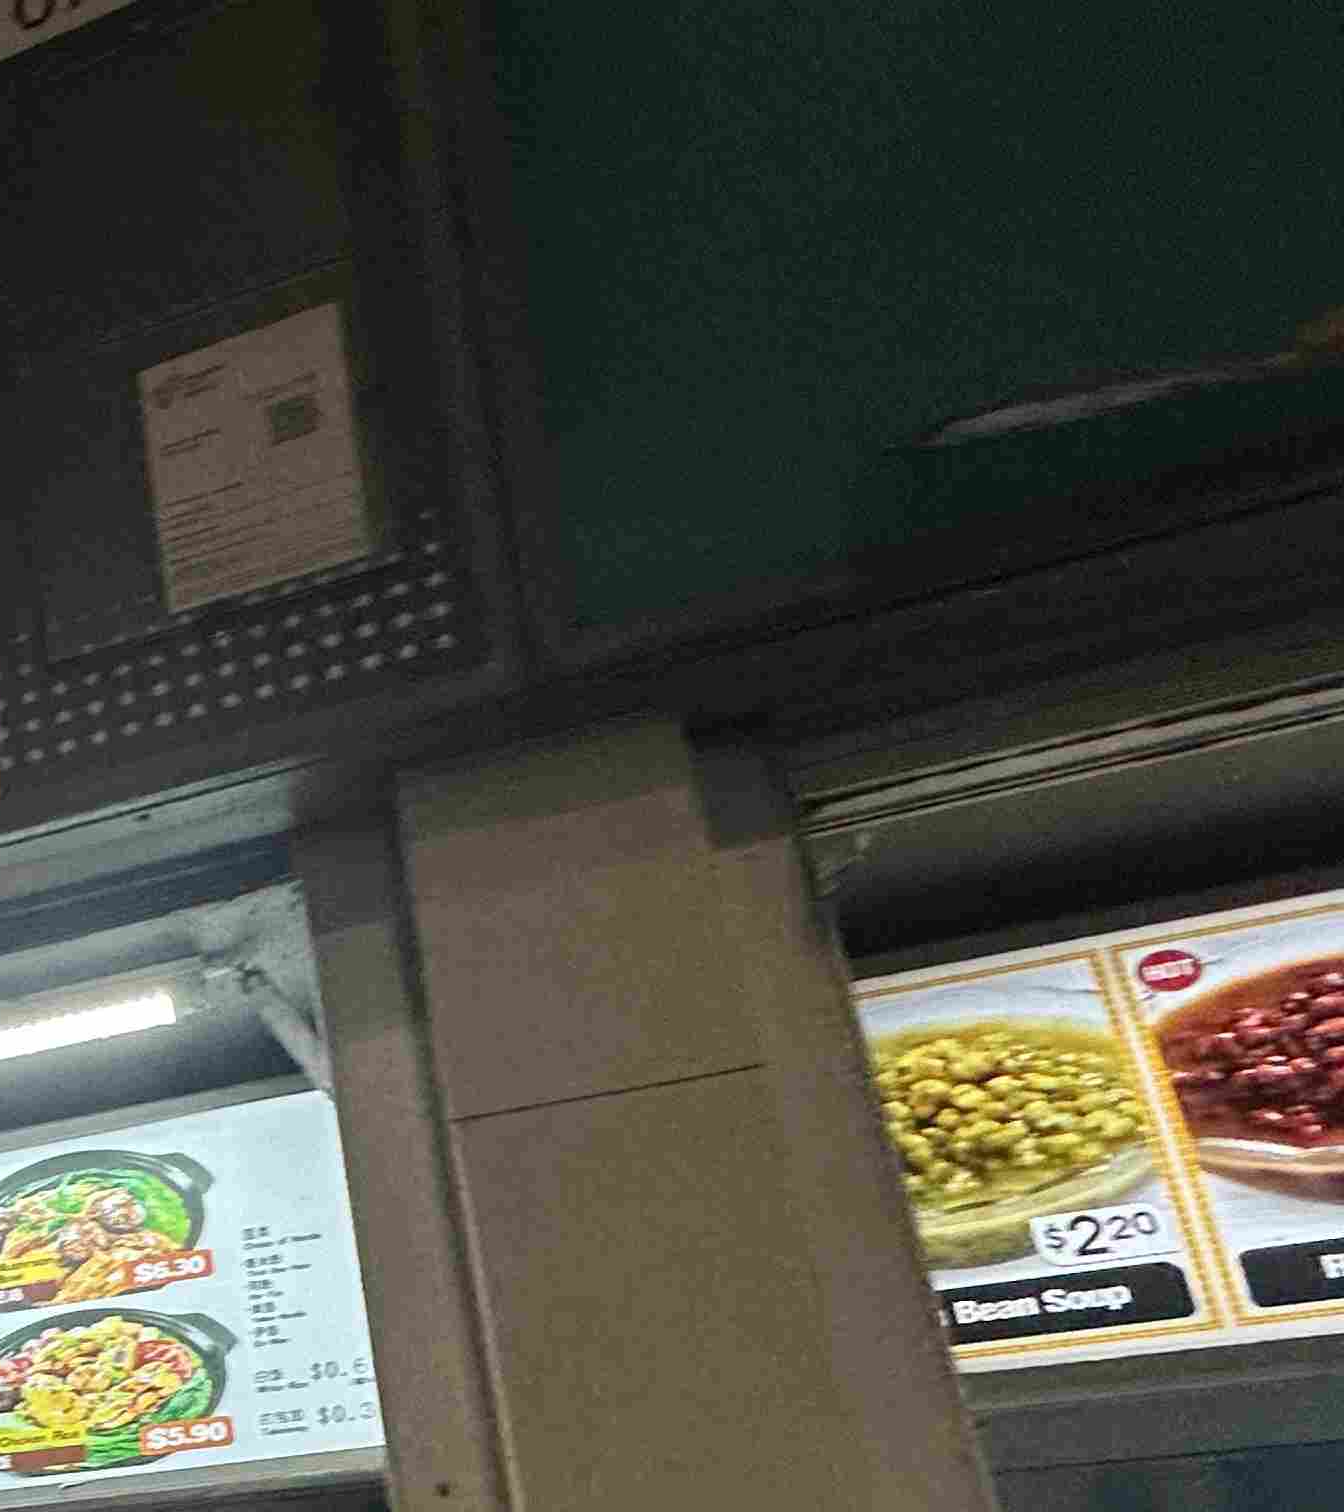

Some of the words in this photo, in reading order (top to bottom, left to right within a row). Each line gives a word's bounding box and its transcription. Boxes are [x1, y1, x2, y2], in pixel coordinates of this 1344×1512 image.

[952, 1296, 1040, 1326] Bean
[1041, 1284, 1133, 1313] Soup
[143, 1422, 226, 1450] $5.90
